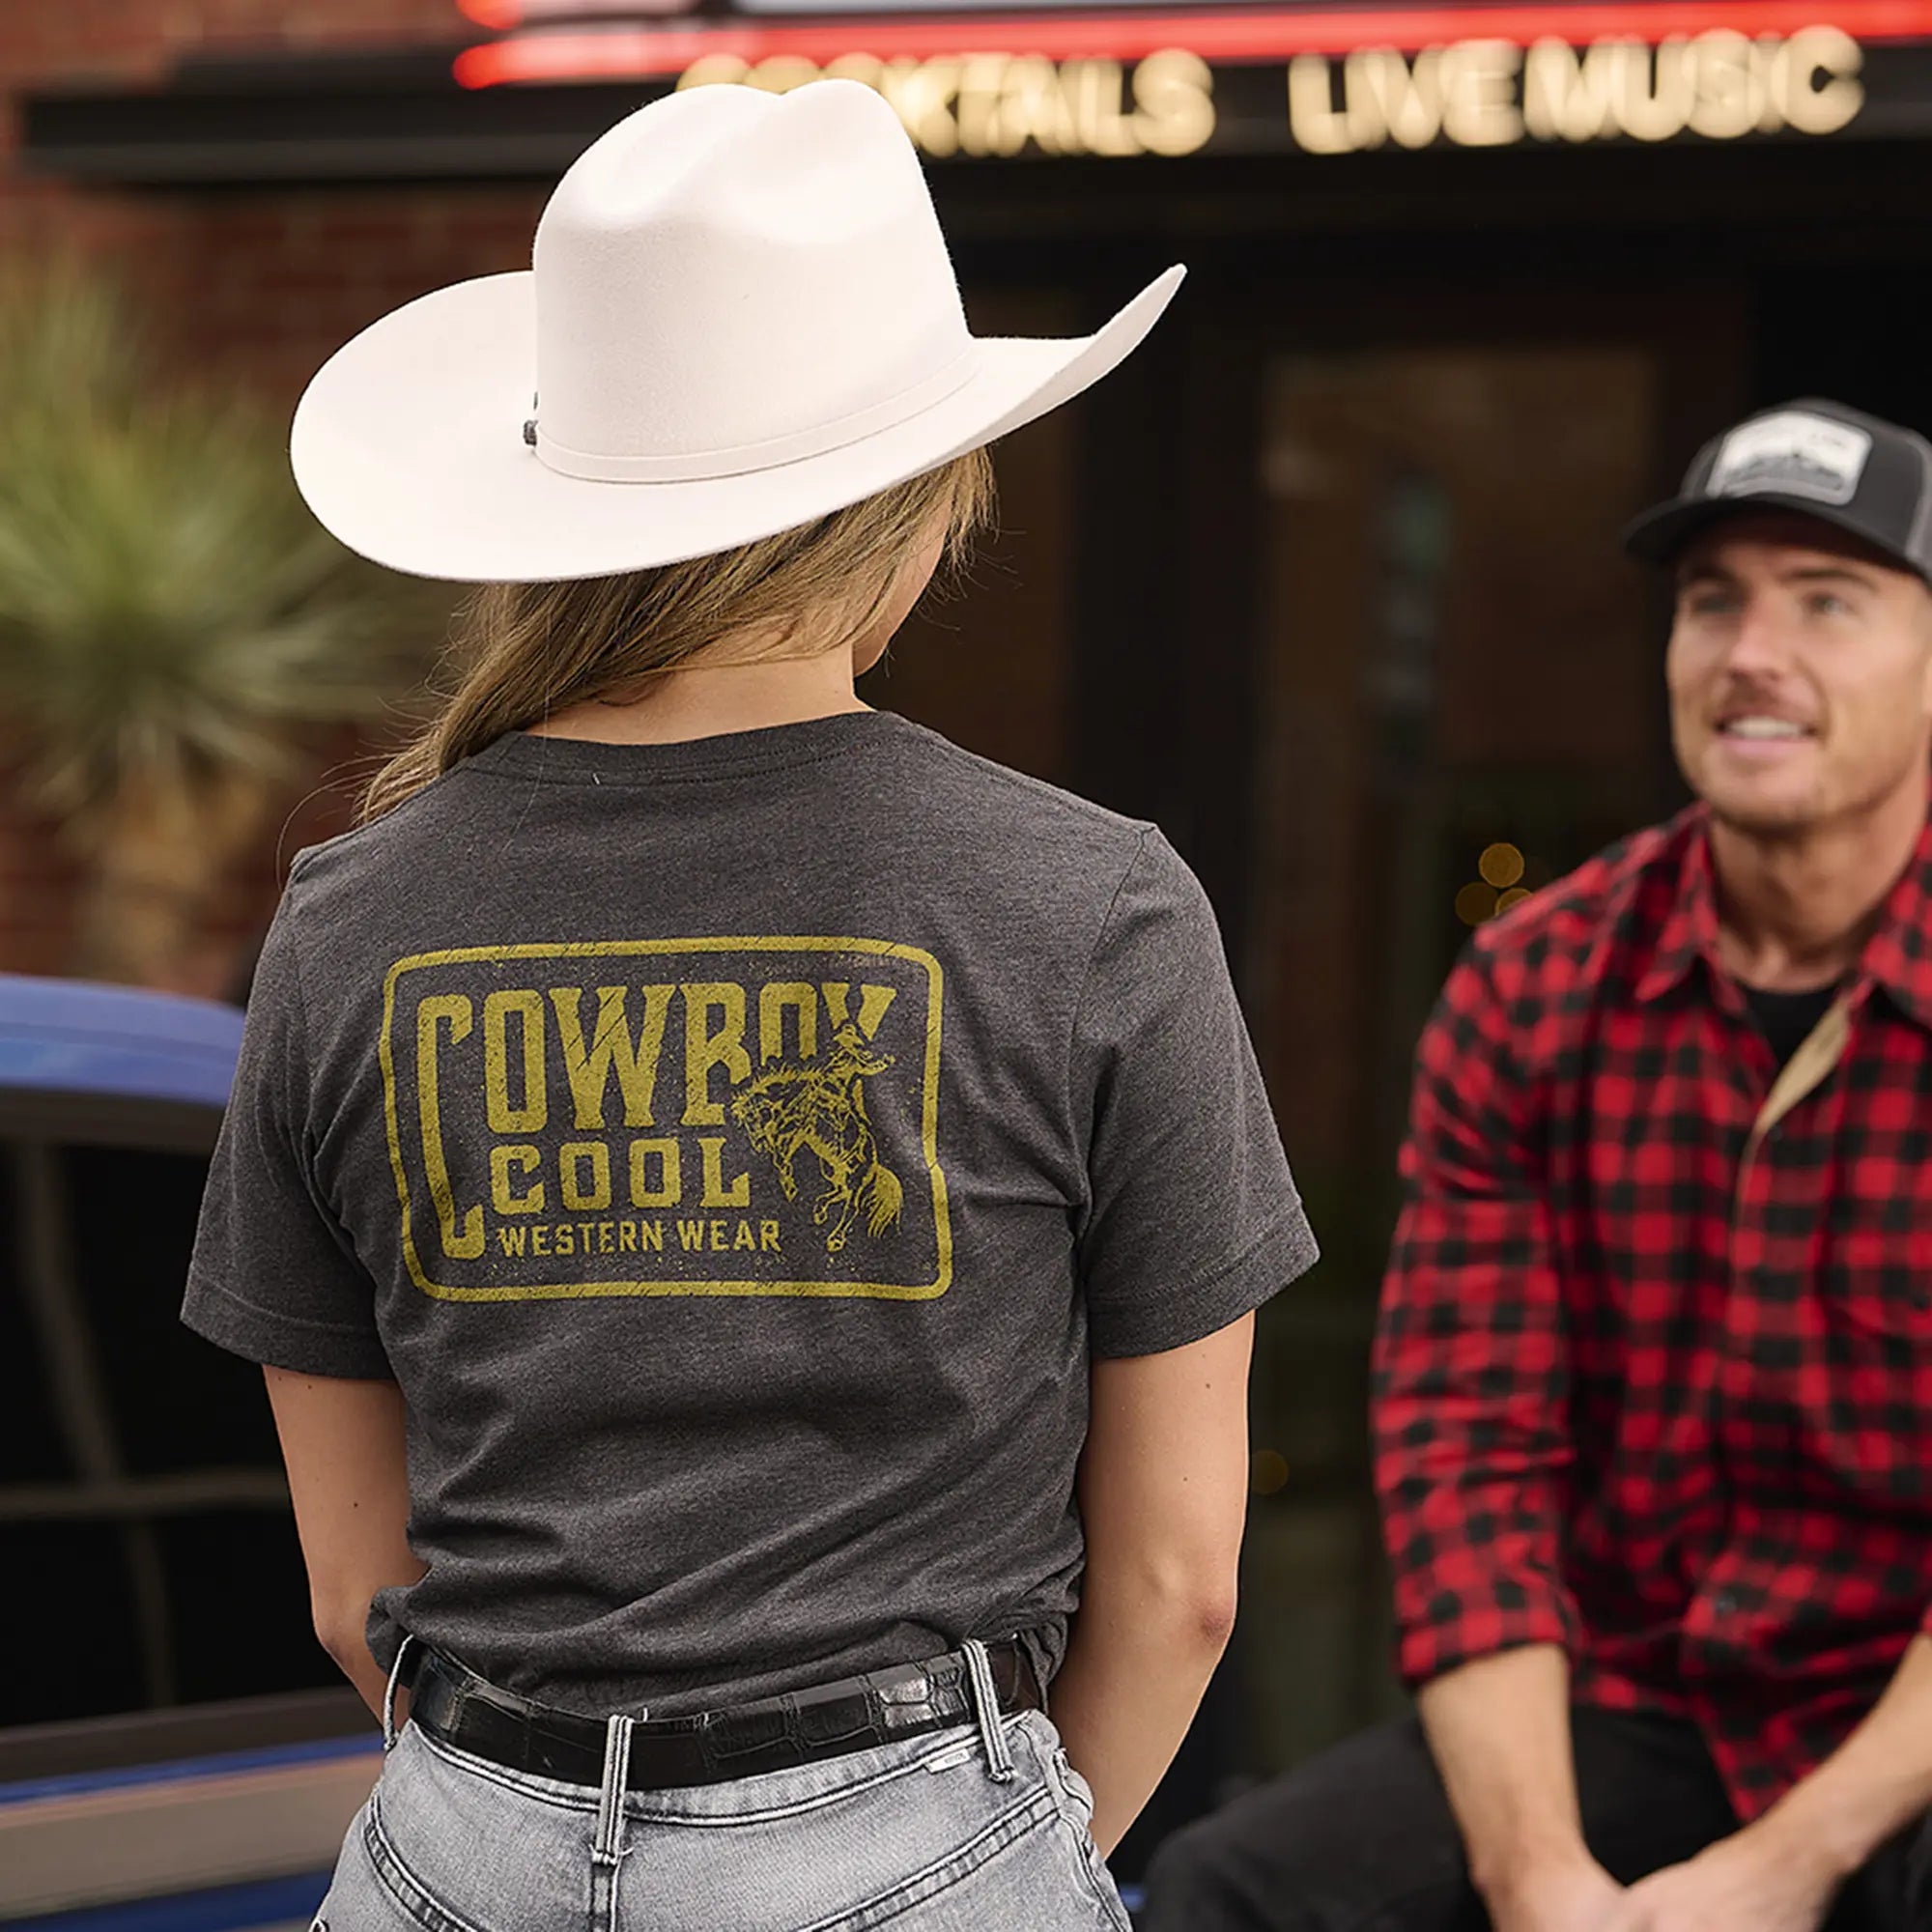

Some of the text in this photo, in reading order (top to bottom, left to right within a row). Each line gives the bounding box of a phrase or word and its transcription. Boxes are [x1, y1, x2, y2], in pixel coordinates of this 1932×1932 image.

[676, 24, 1864, 157] KTAILS LIVE MUSIC
[489, 1137, 751, 1215] COOL
[497, 1219, 781, 1257] WESTERN WEAR
